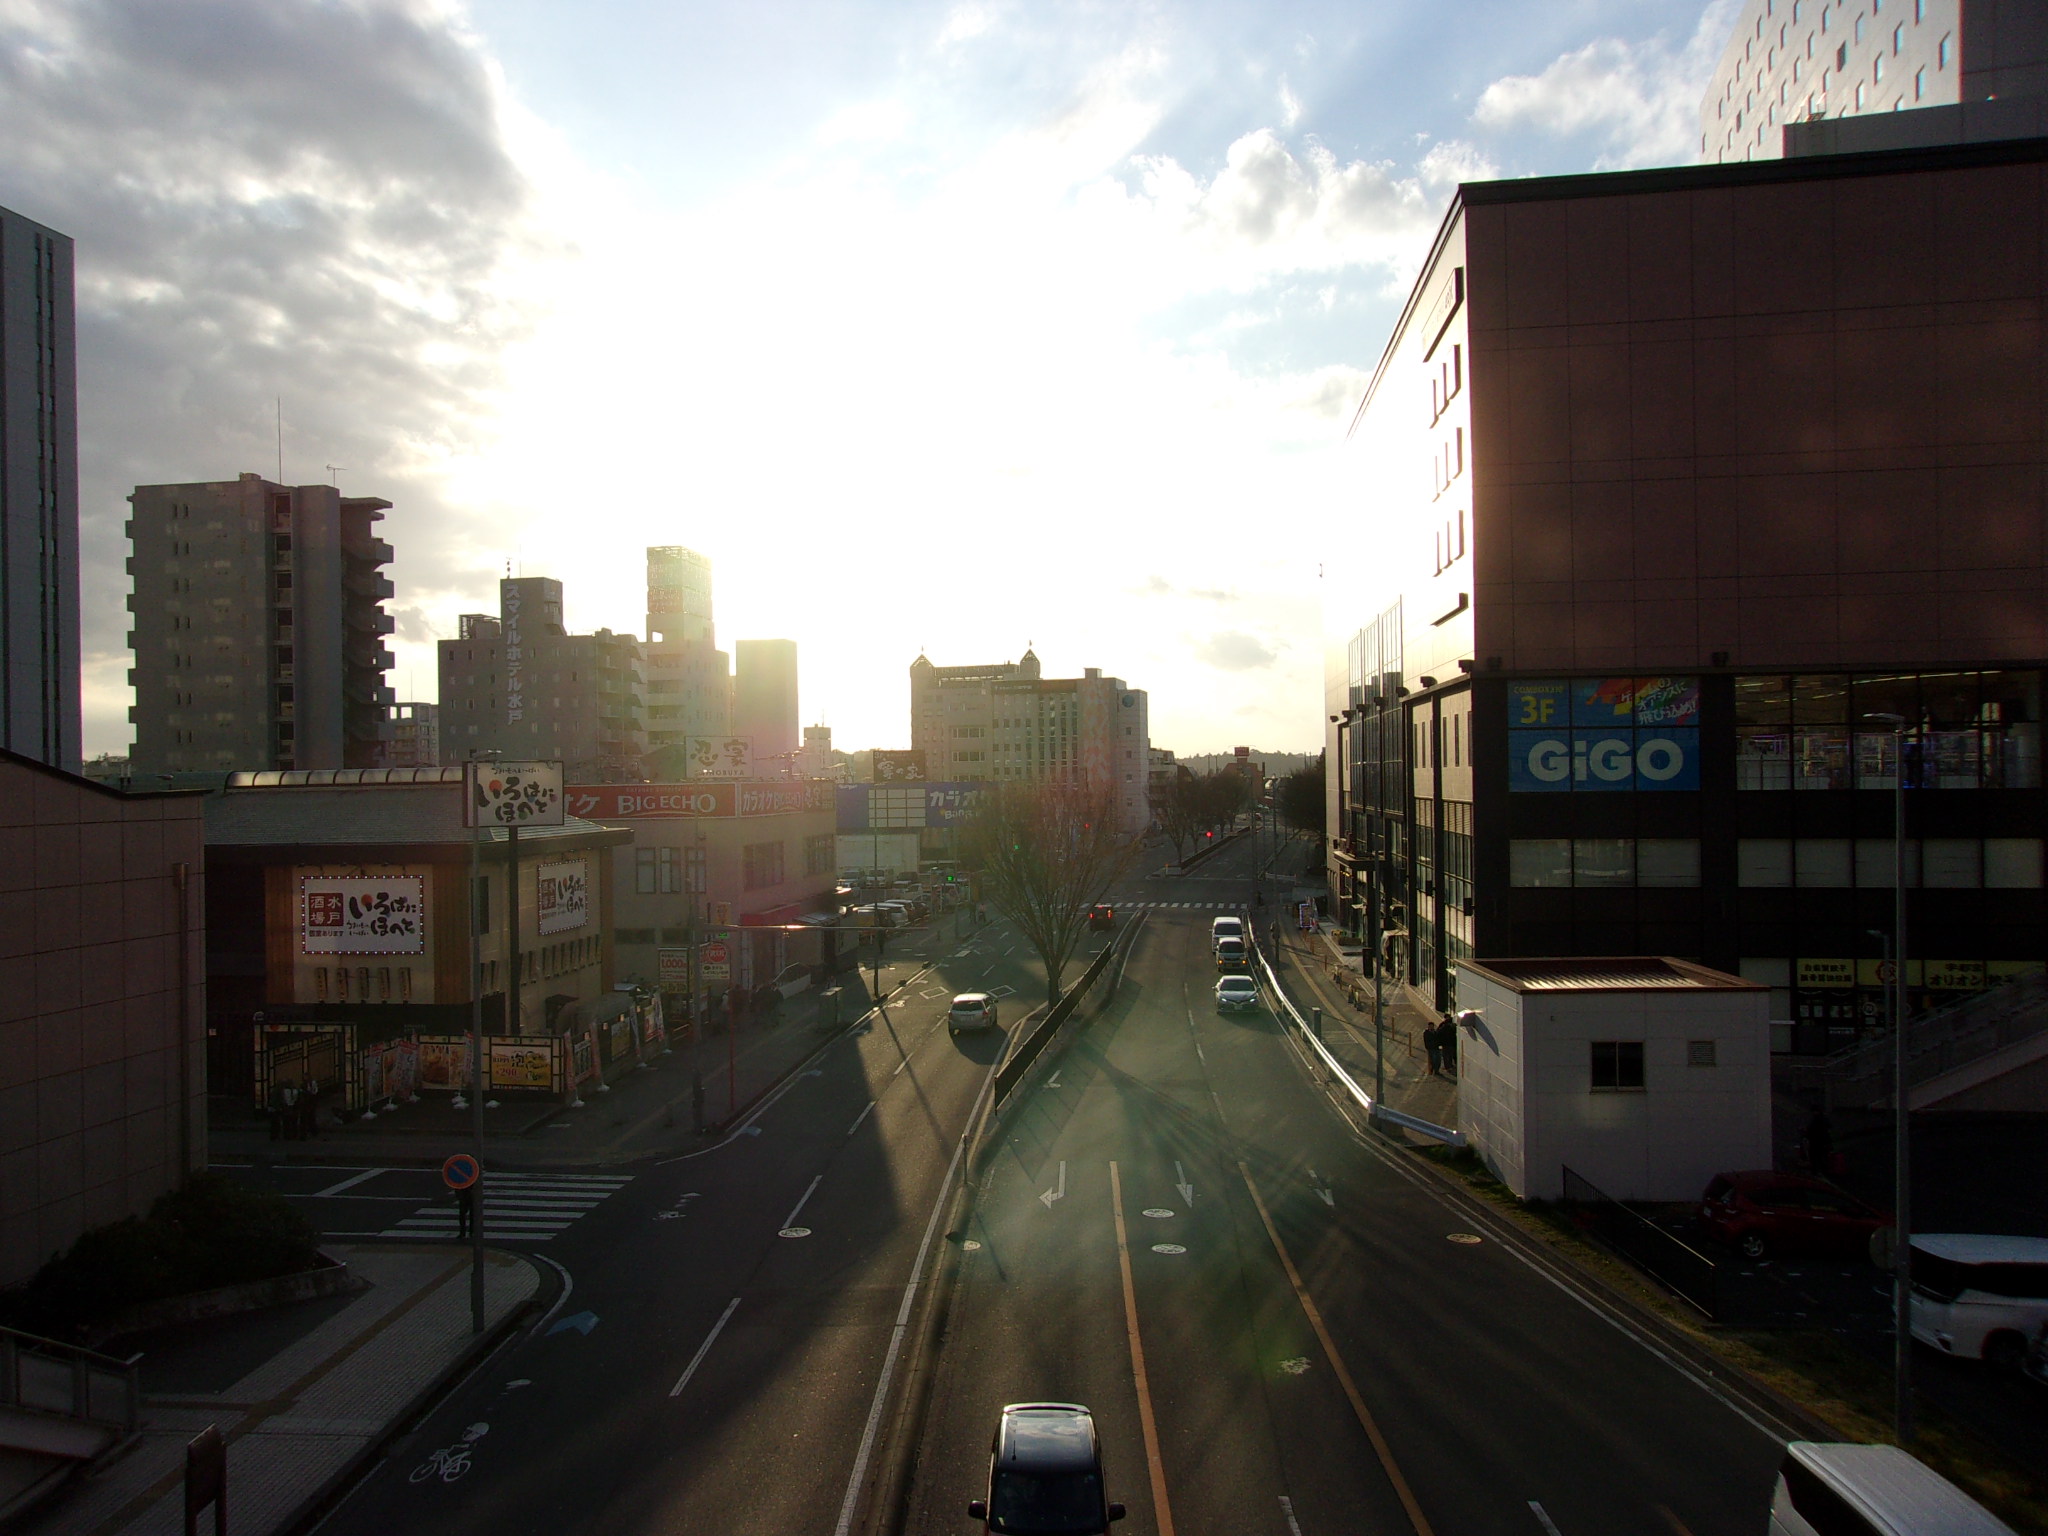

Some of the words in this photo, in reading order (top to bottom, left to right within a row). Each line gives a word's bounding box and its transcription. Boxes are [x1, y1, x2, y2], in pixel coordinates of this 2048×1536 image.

[506, 584, 523, 726] スマイルホテル水戸
[1520, 695, 1556, 724] 3F
[690, 739, 749, 767] 忍家
[1527, 738, 1684, 782] GiGO
[697, 767, 744, 777] NOBUYA
[477, 777, 557, 807] いろはに
[617, 795, 656, 815] BIG
[660, 793, 717, 813] ECHO
[743, 789, 773, 813] カラオケ
[495, 799, 548, 823] ほへと
[310, 896, 326, 925] 酒場
[327, 896, 342, 925] 水戸
[349, 892, 417, 919] いろはに
[371, 916, 415, 937] ほへと
